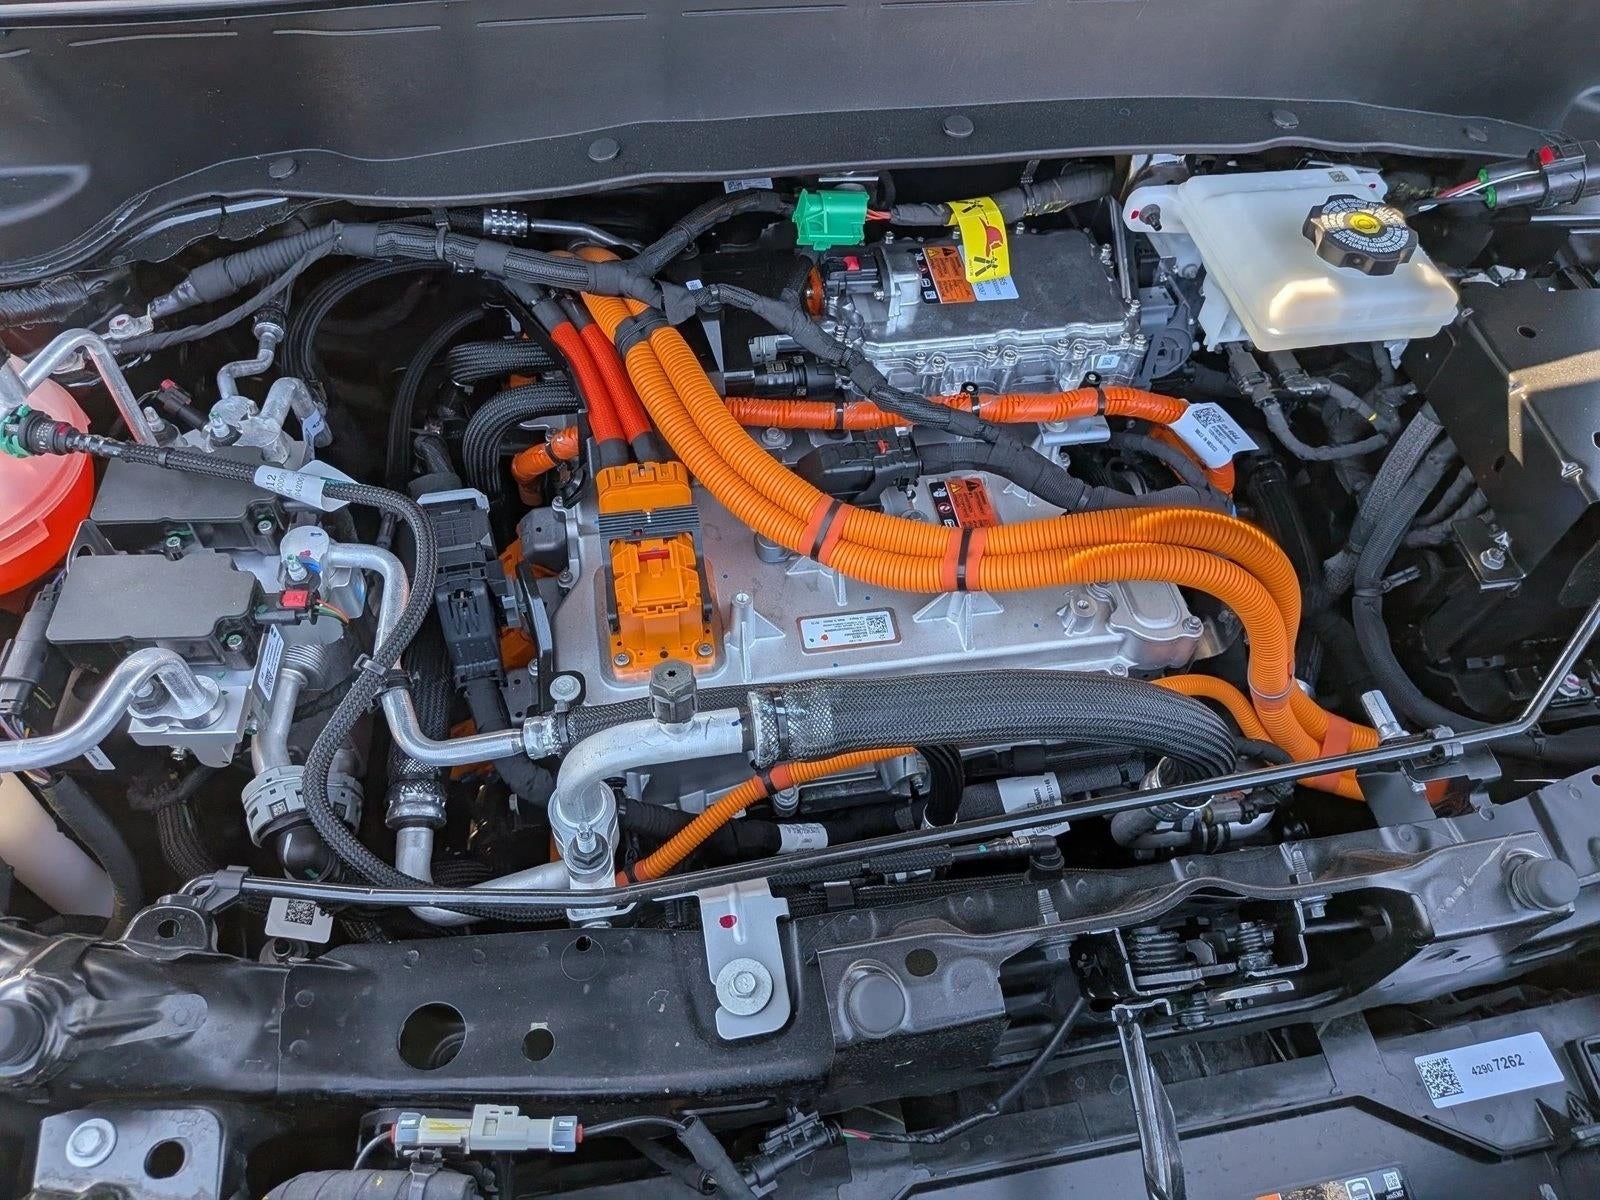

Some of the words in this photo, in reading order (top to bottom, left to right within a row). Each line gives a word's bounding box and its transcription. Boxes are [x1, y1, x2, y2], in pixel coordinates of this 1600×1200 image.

[1346, 240, 1362, 249] FLUID
[1472, 1063, 1493, 1075] 4290
[1492, 1054, 1524, 1070] 7262
